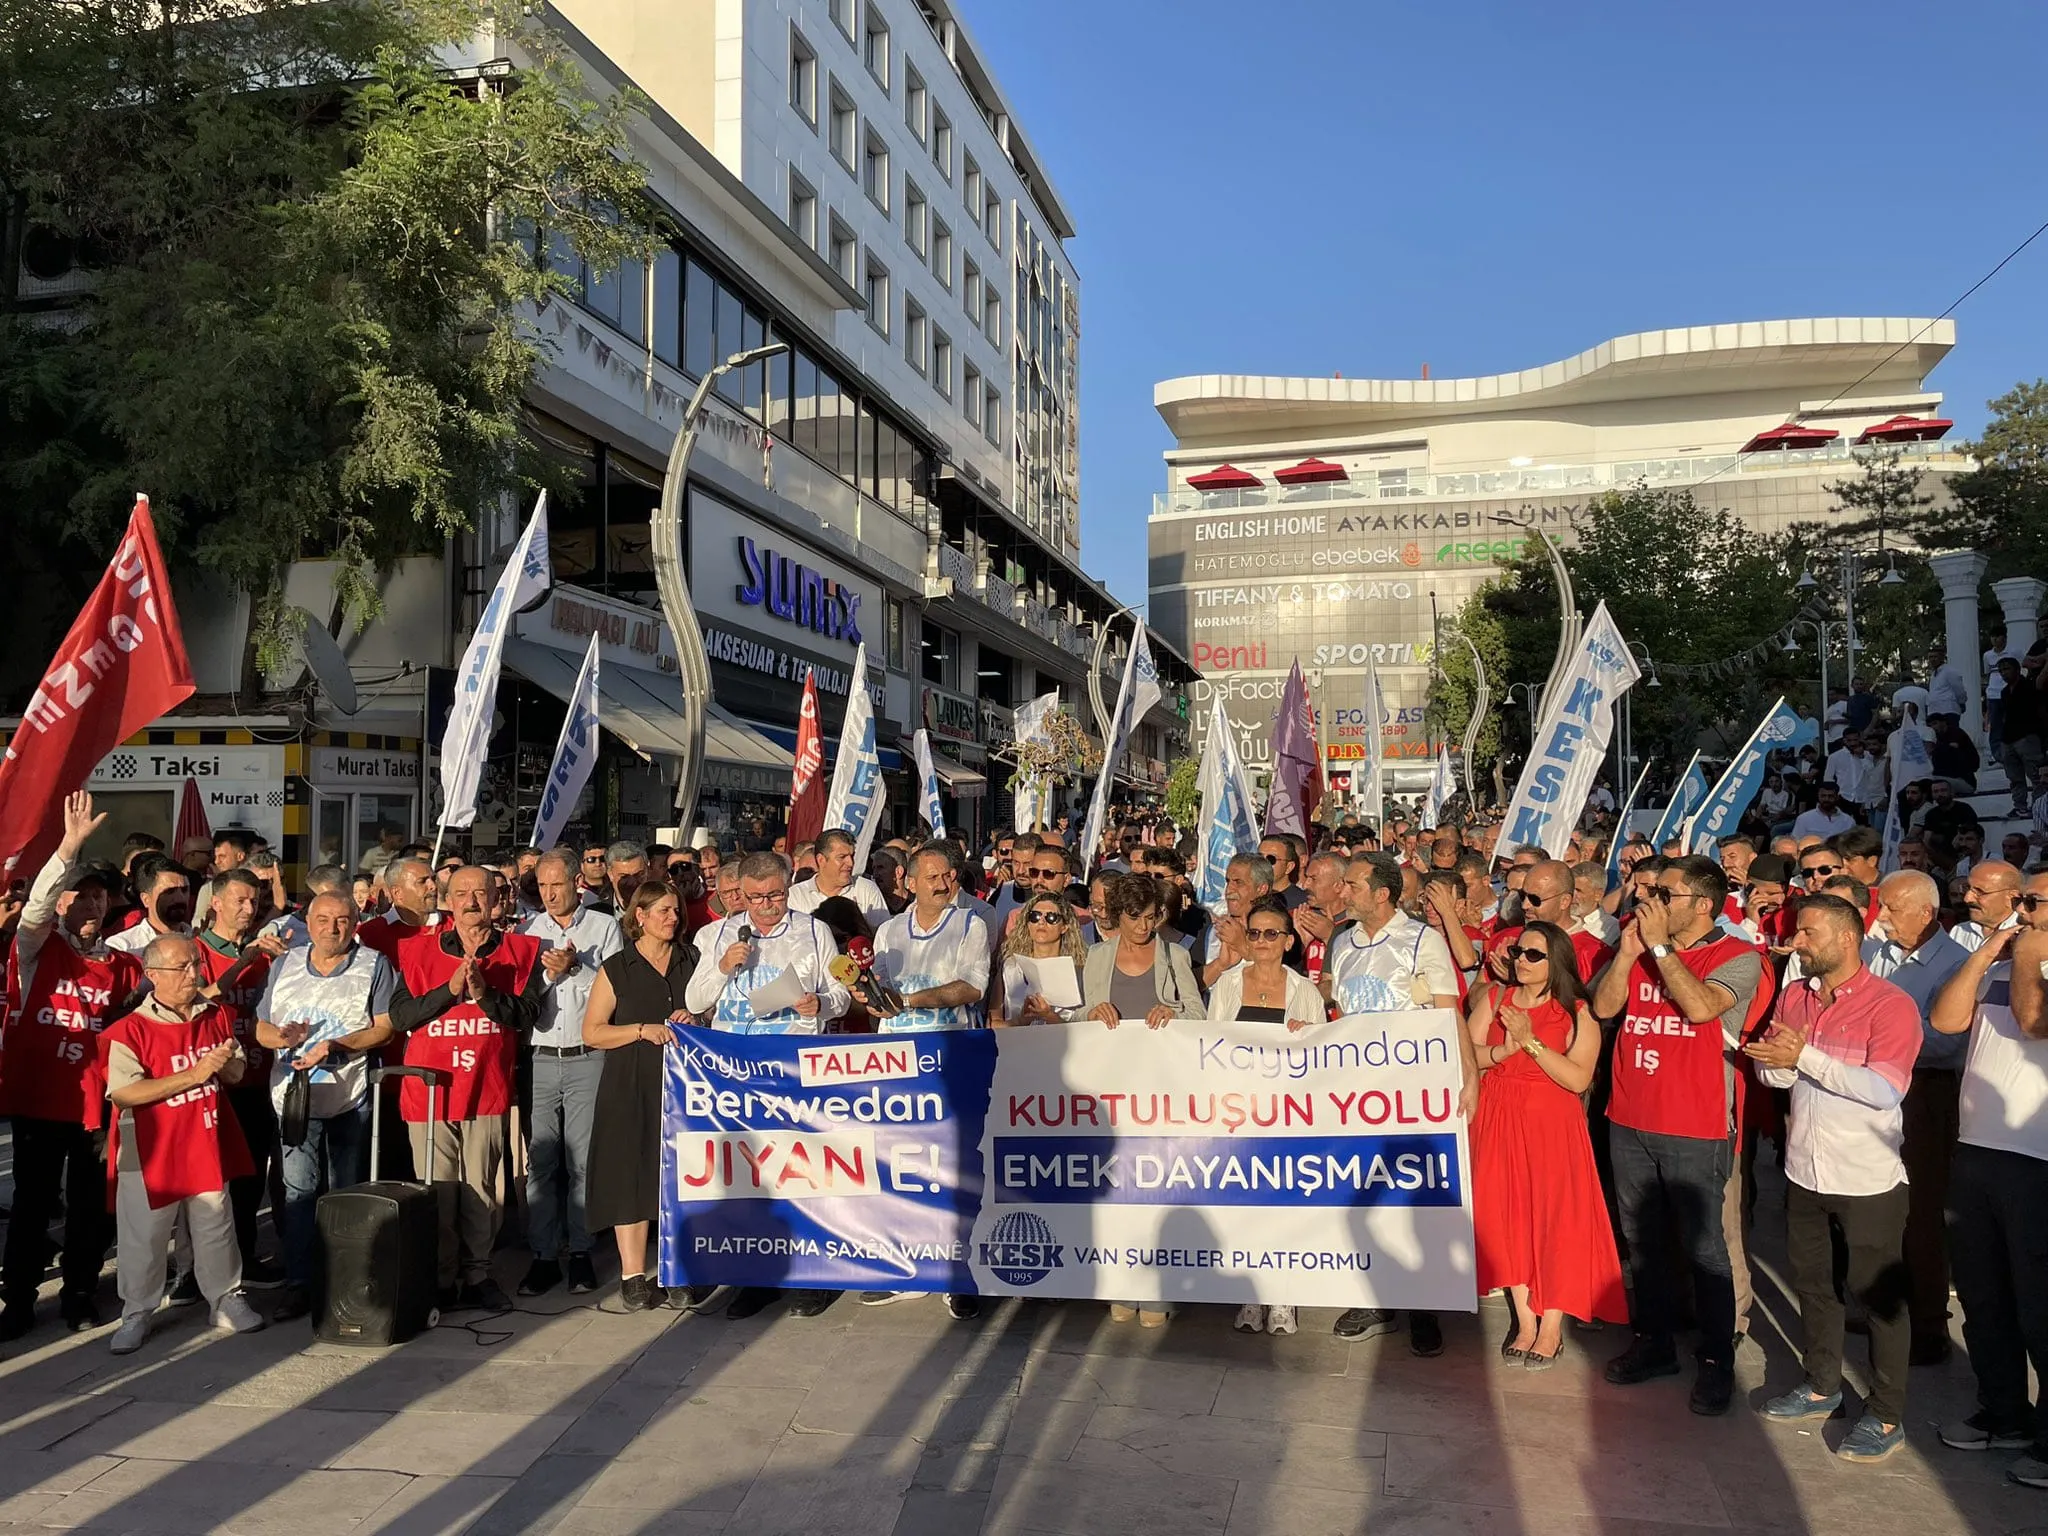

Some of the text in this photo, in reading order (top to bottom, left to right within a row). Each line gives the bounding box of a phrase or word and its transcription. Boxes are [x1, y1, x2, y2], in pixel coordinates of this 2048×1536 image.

[1195, 515, 1326, 541] ENGLISH HOME
[1337, 510, 1482, 532] AYAKKABI
[1312, 546, 1400, 566] ebebek
[1194, 582, 1411, 608] TIFFANY & TOMATO
[705, 628, 775, 675] AKSESUAR
[1193, 641, 1268, 671] Penti
[151, 757, 219, 776] Taksi
[338, 756, 418, 778] Murat Taksi
[211, 792, 259, 805] Murat
[37, 1006, 103, 1032] GENE
[427, 1017, 501, 1038] GENEL
[57, 1036, 85, 1065] İŞ
[452, 1045, 476, 1073] İŞ
[803, 1050, 908, 1077] TALAN
[918, 1048, 942, 1074] e!
[1199, 1030, 1450, 1080] Kayyımdan
[1634, 1043, 1660, 1075] İŞ
[684, 1082, 944, 1124] Berxwedan
[1008, 1086, 1452, 1134] KURTULUŞUN YOLU
[683, 1139, 941, 1194] JIYAN E!
[1003, 1152, 1451, 1198] EMEK DAYANIŞMASI!
[694, 1236, 820, 1257] PLATFORMA
[979, 1242, 1065, 1269] KESK
[1074, 1247, 1372, 1272] VAN ŞUBELER PLATFORMU
[1007, 1270, 1034, 1285] 1995
